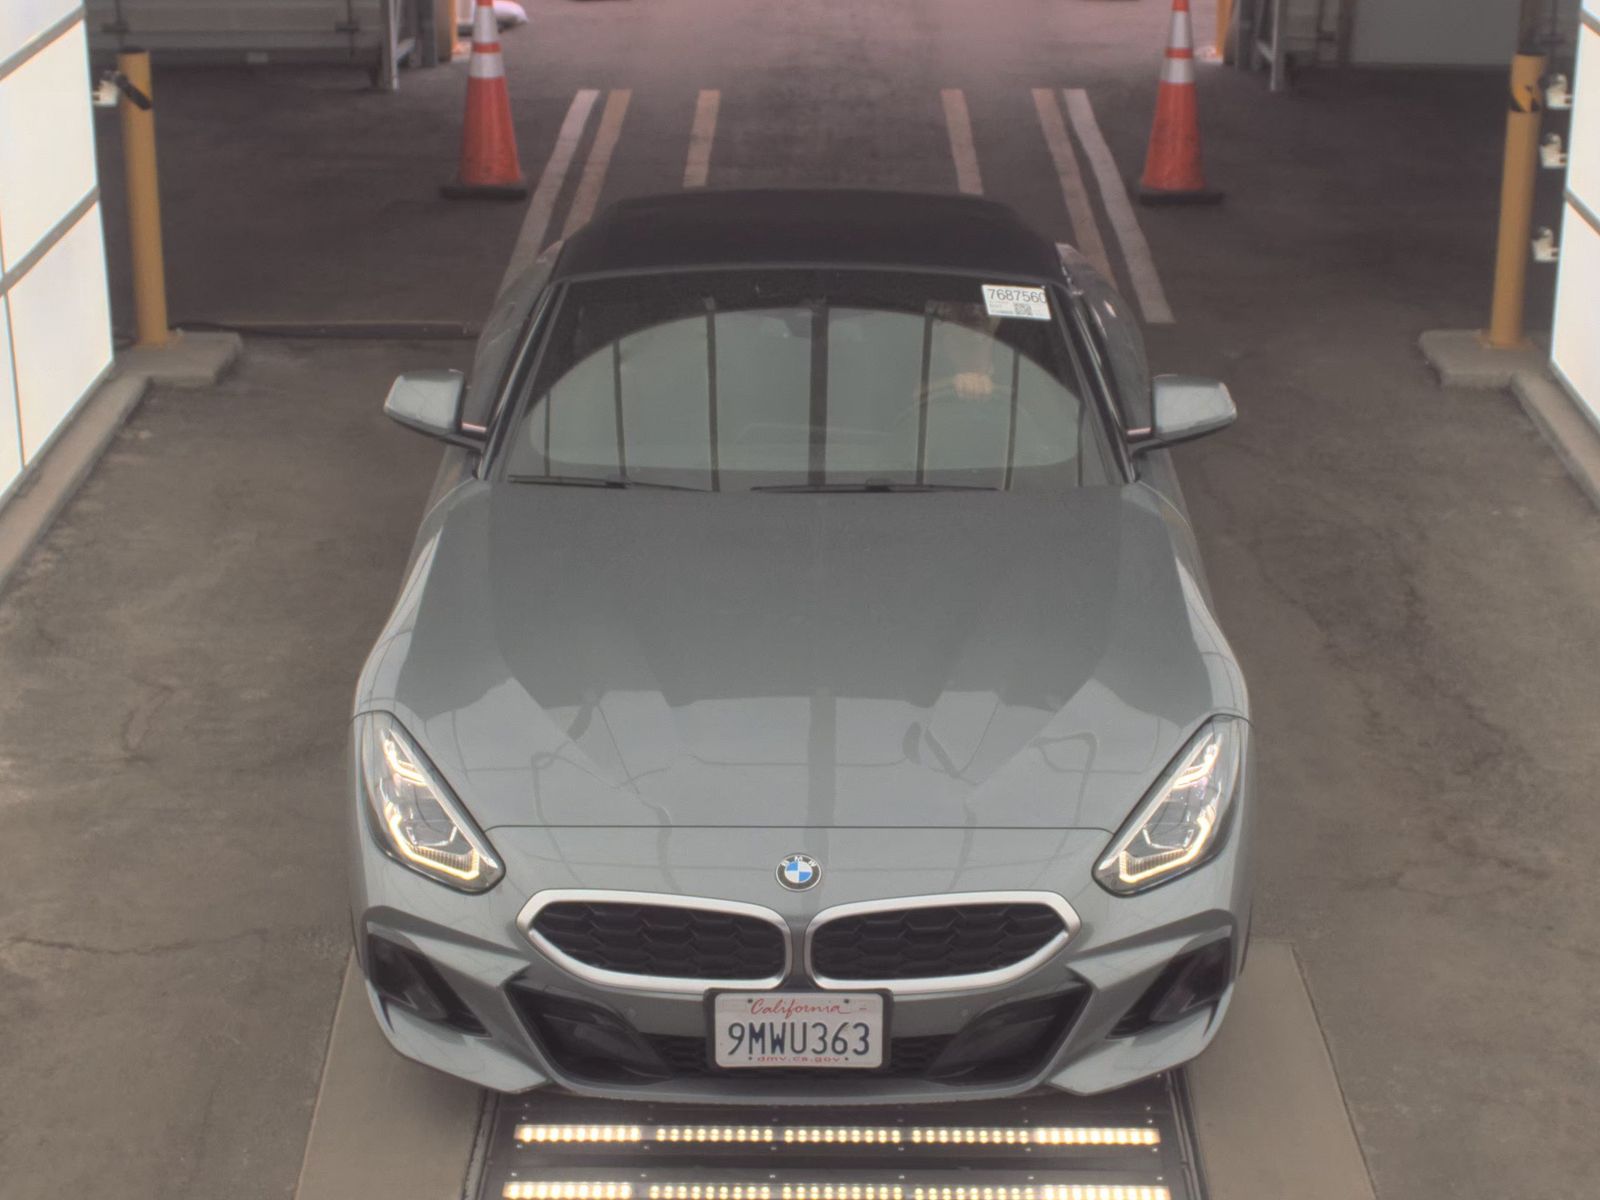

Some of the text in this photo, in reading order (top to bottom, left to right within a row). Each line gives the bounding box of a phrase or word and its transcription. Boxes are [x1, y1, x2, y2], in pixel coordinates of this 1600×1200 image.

[781, 855, 817, 867] BMW
[751, 998, 850, 1019] California
[728, 1022, 870, 1055] 9MWU363
